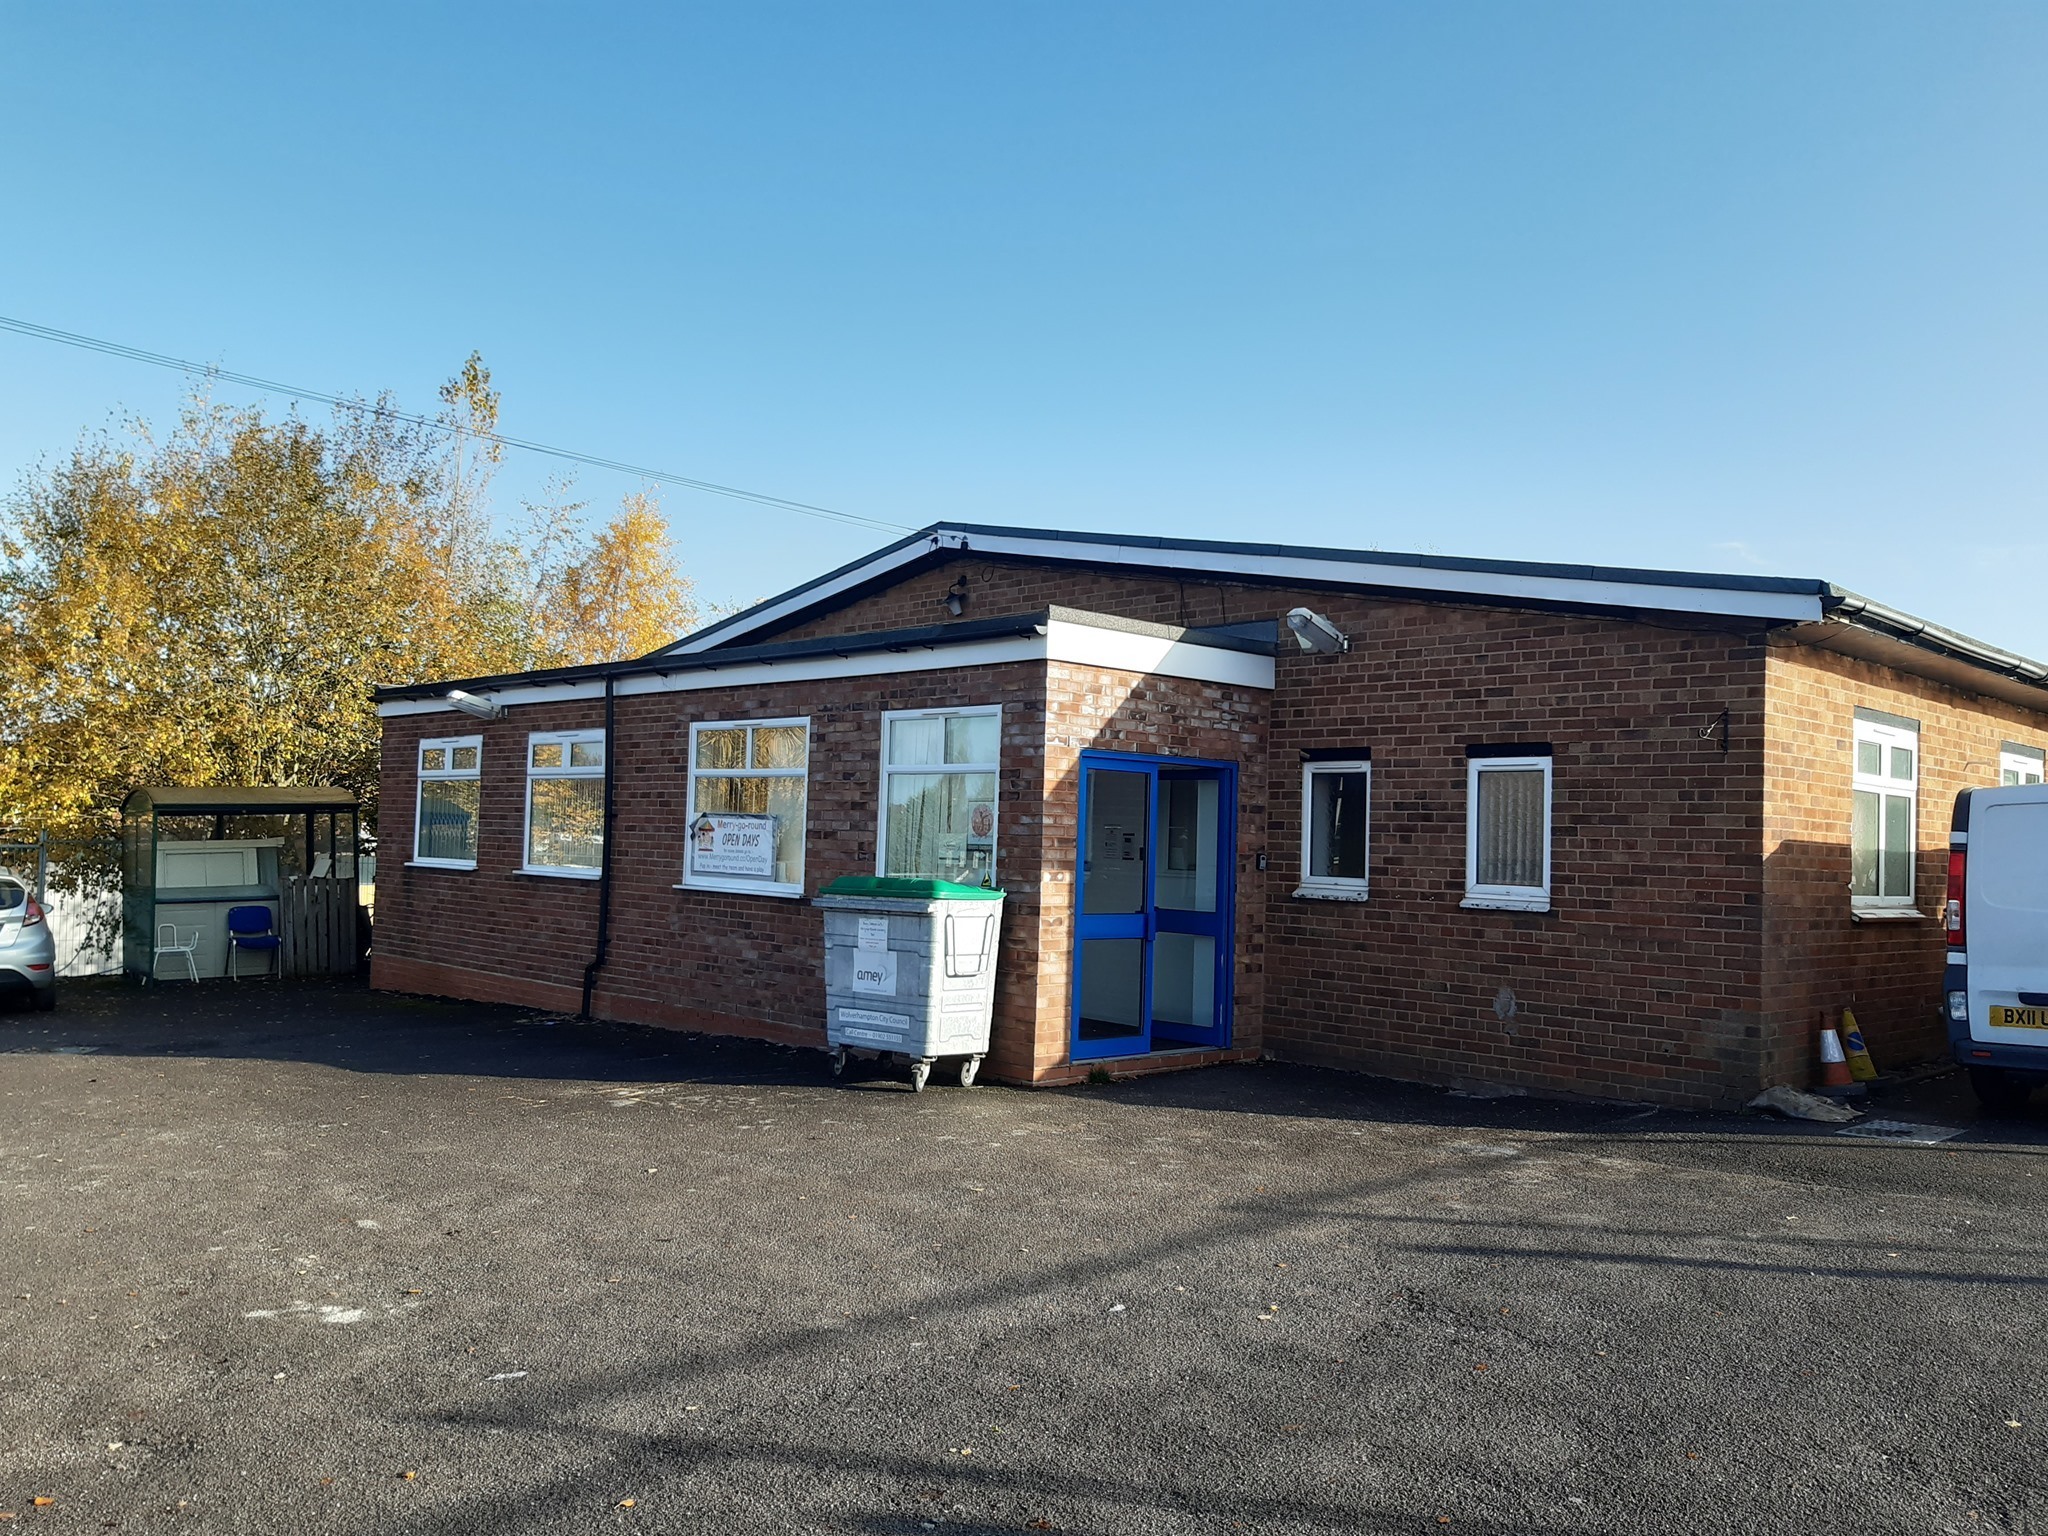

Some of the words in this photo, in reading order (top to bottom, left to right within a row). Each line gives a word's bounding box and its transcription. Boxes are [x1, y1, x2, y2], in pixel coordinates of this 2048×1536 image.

[717, 819, 767, 831] Merry-go-round
[722, 833, 741, 846] OPEN
[742, 834, 760, 847] DAYS
[857, 970, 883, 986] amey
[840, 1010, 879, 1021] Wolverhampton
[879, 1014, 889, 1024] City
[889, 1015, 908, 1026] Council
